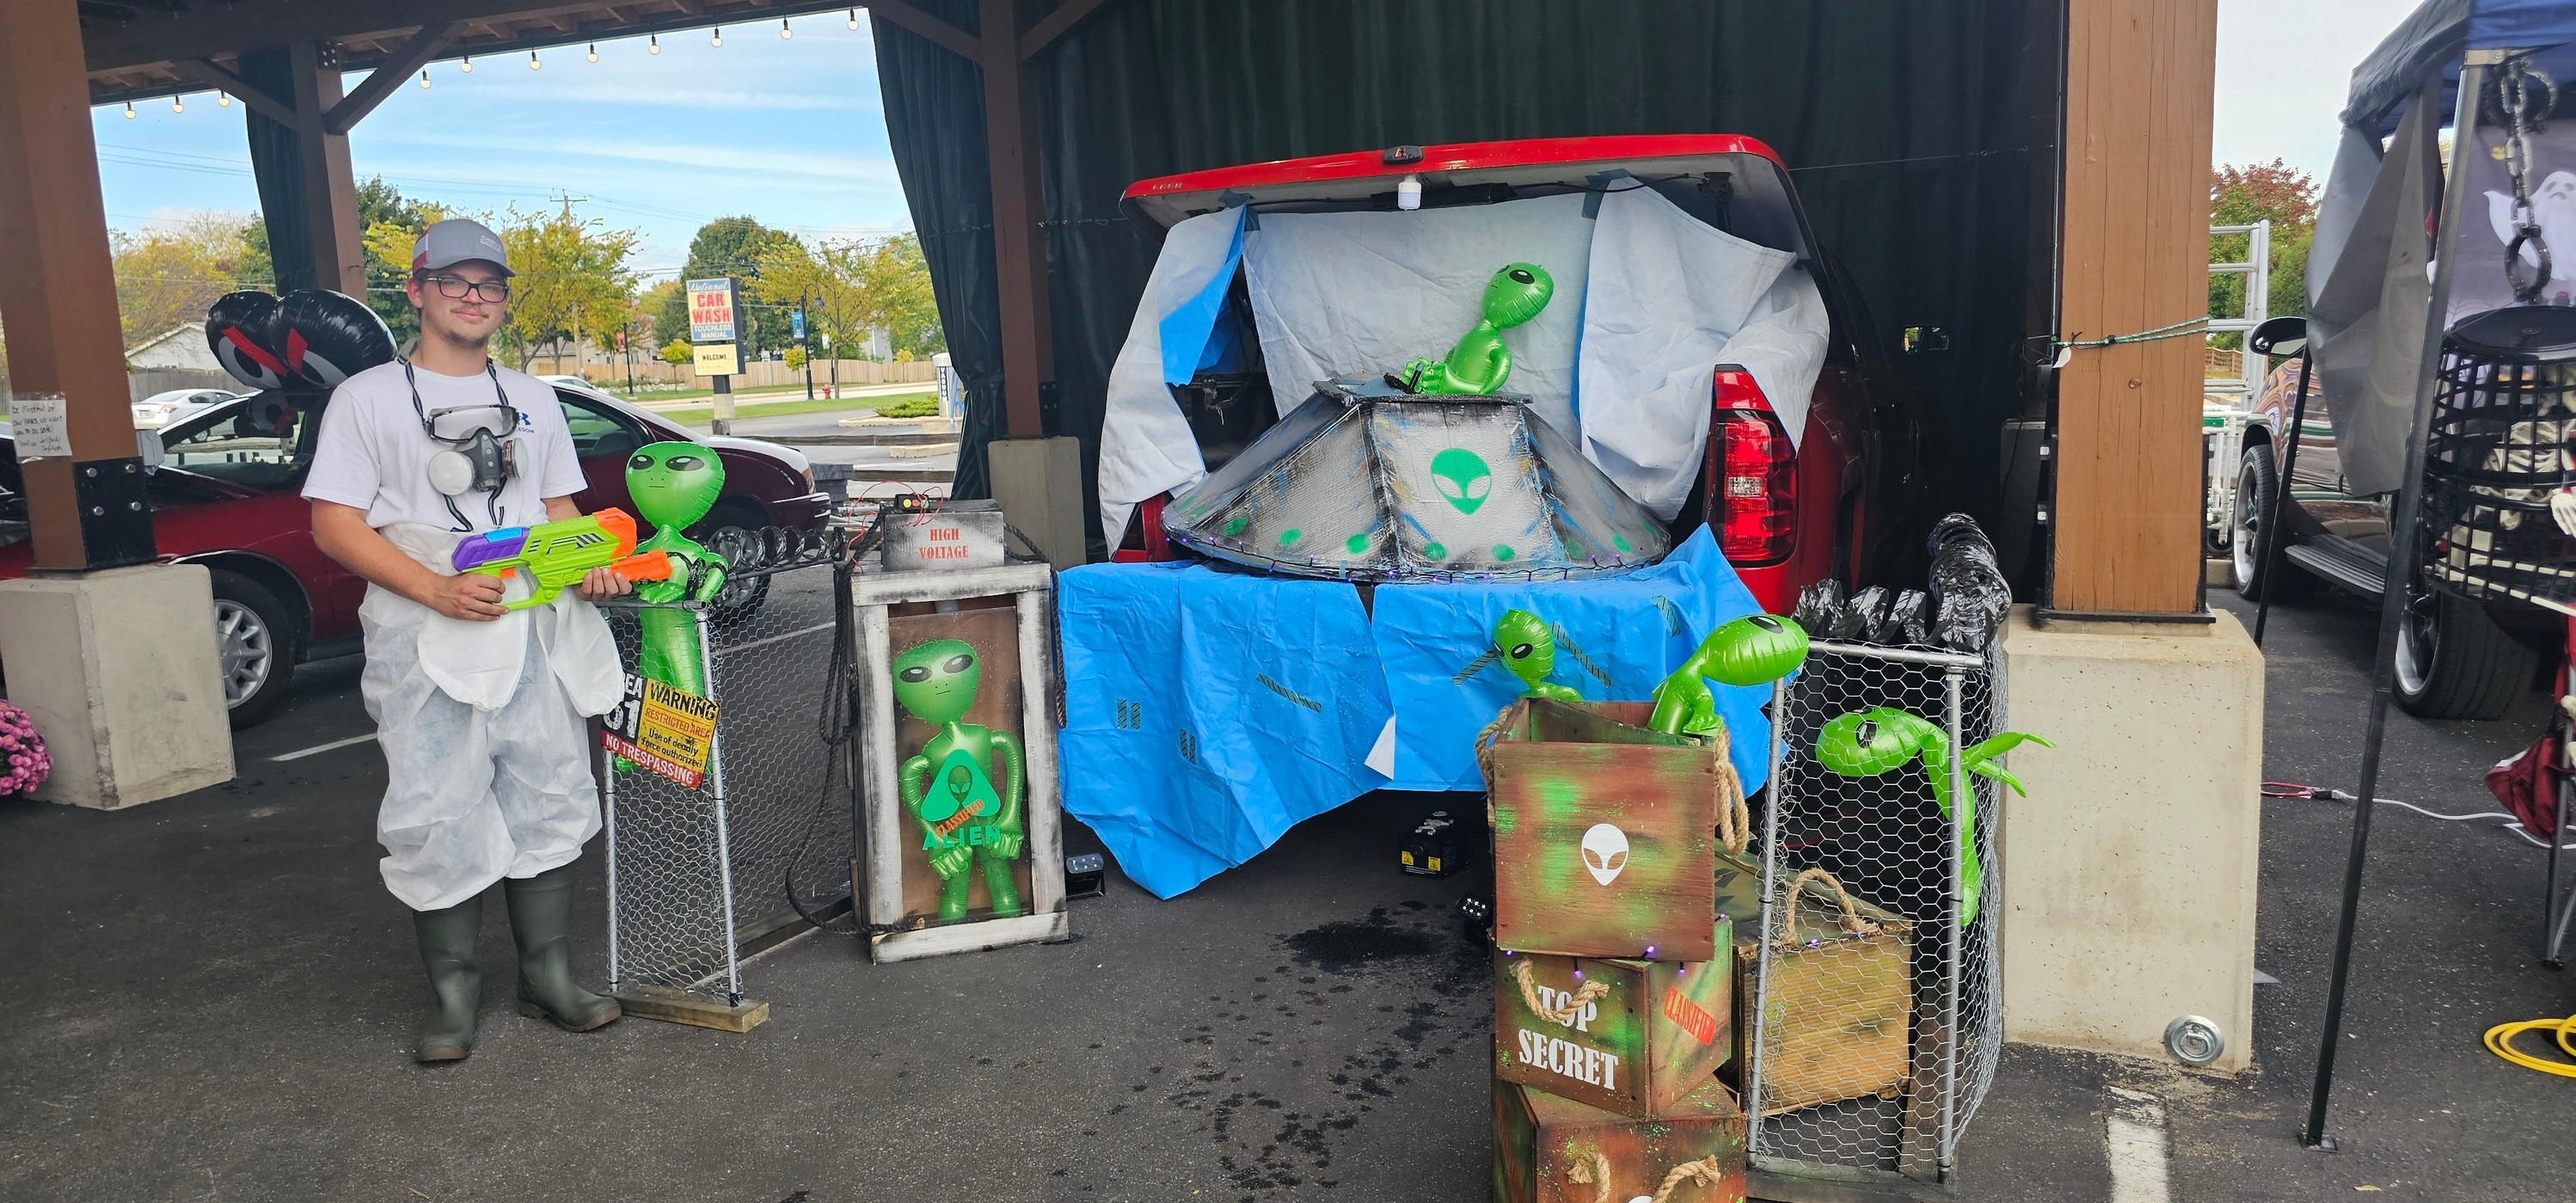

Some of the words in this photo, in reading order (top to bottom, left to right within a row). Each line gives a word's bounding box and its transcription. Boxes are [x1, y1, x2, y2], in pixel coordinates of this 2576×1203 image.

[690, 280, 728, 292] National
[696, 293, 725, 308] CAR
[691, 309, 731, 324] WASH
[940, 366, 948, 402] VACUUM
[929, 528, 960, 542] HIGH
[918, 545, 969, 560] VOLTAGE
[623, 673, 643, 698] EA
[650, 683, 719, 721] WARNING
[646, 707, 690, 733] RESTRICTED
[689, 724, 710, 740] AREA
[641, 737, 661, 752] force
[661, 747, 702, 768] authorized
[648, 727, 662, 740] Use
[663, 736, 672, 745] of
[672, 738, 699, 757] deadly
[606, 733, 620, 751] NO
[622, 742, 695, 784] TRESPASSING
[935, 799, 984, 838] CLASSIFIED
[922, 825, 1002, 850] ALIEN
[1537, 985, 1598, 1033] TOP
[1518, 1028, 1619, 1090] SECRET
